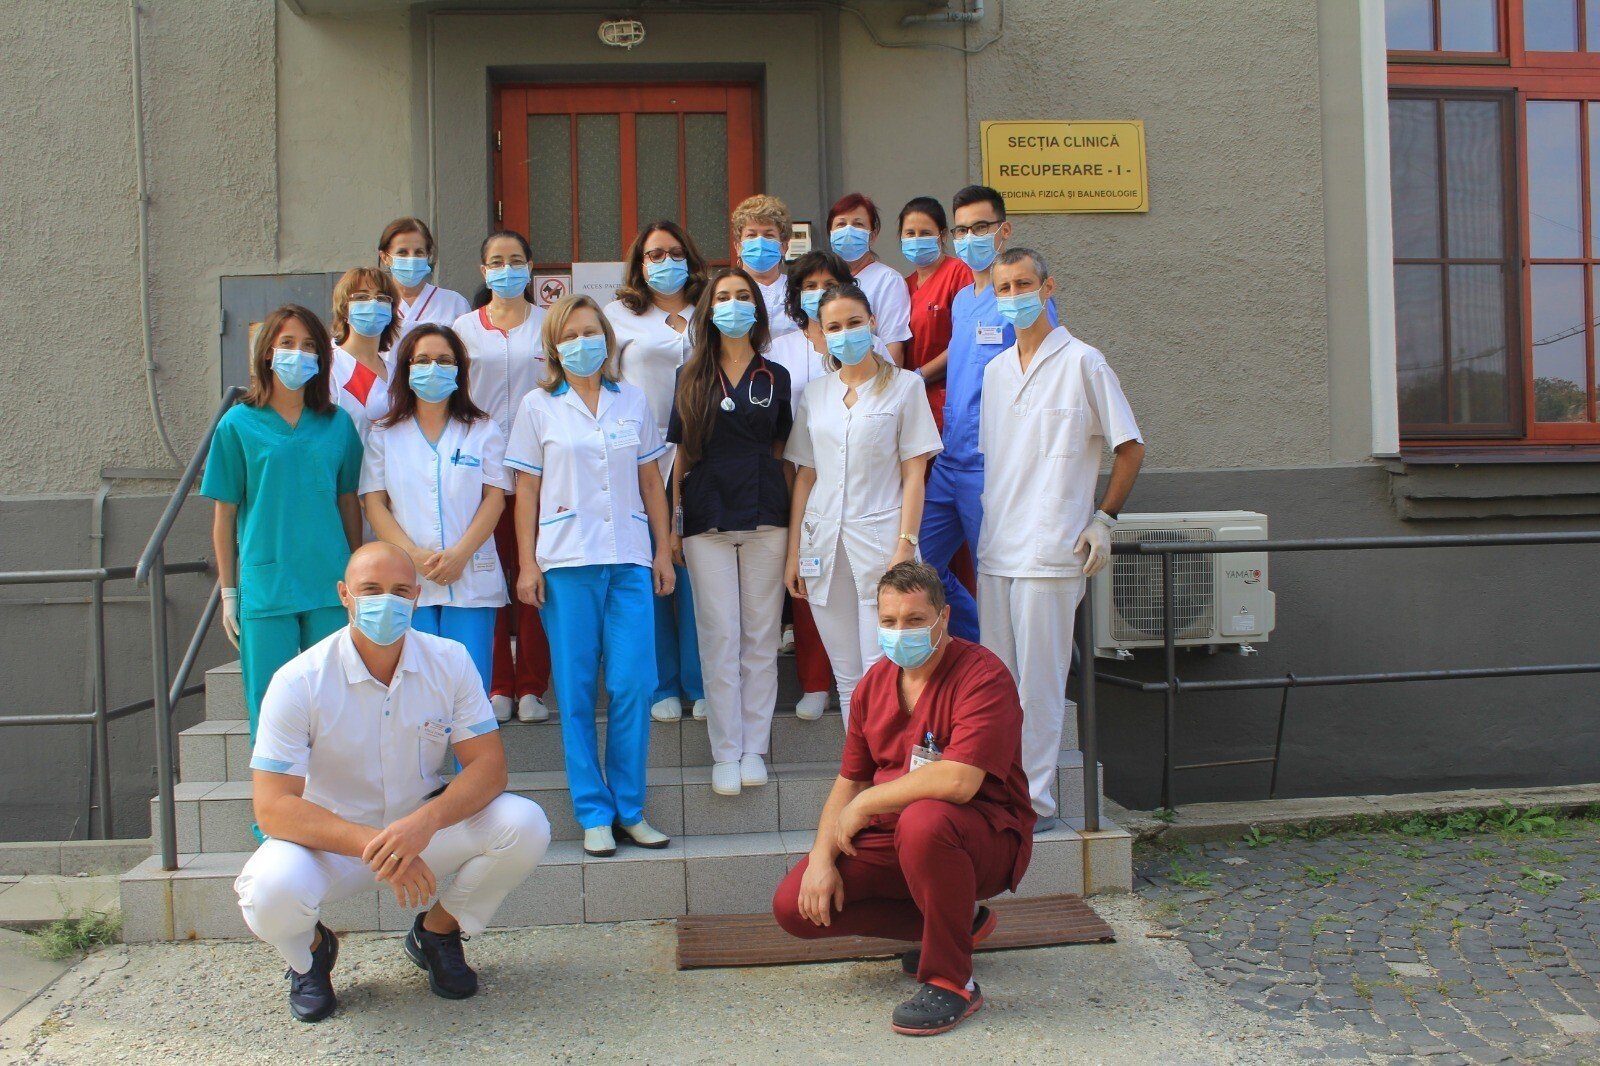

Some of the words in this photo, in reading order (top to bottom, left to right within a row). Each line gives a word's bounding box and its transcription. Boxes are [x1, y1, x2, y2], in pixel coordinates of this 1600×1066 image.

[1063, 134, 1120, 148] CLINICĂ
[1000, 164, 1103, 177] RECUPERARE
[1000, 190, 1036, 198] EDICINĂ
[1077, 189, 1138, 198] BALNEOLOGIE
[1225, 569, 1262, 579] YAMATO
